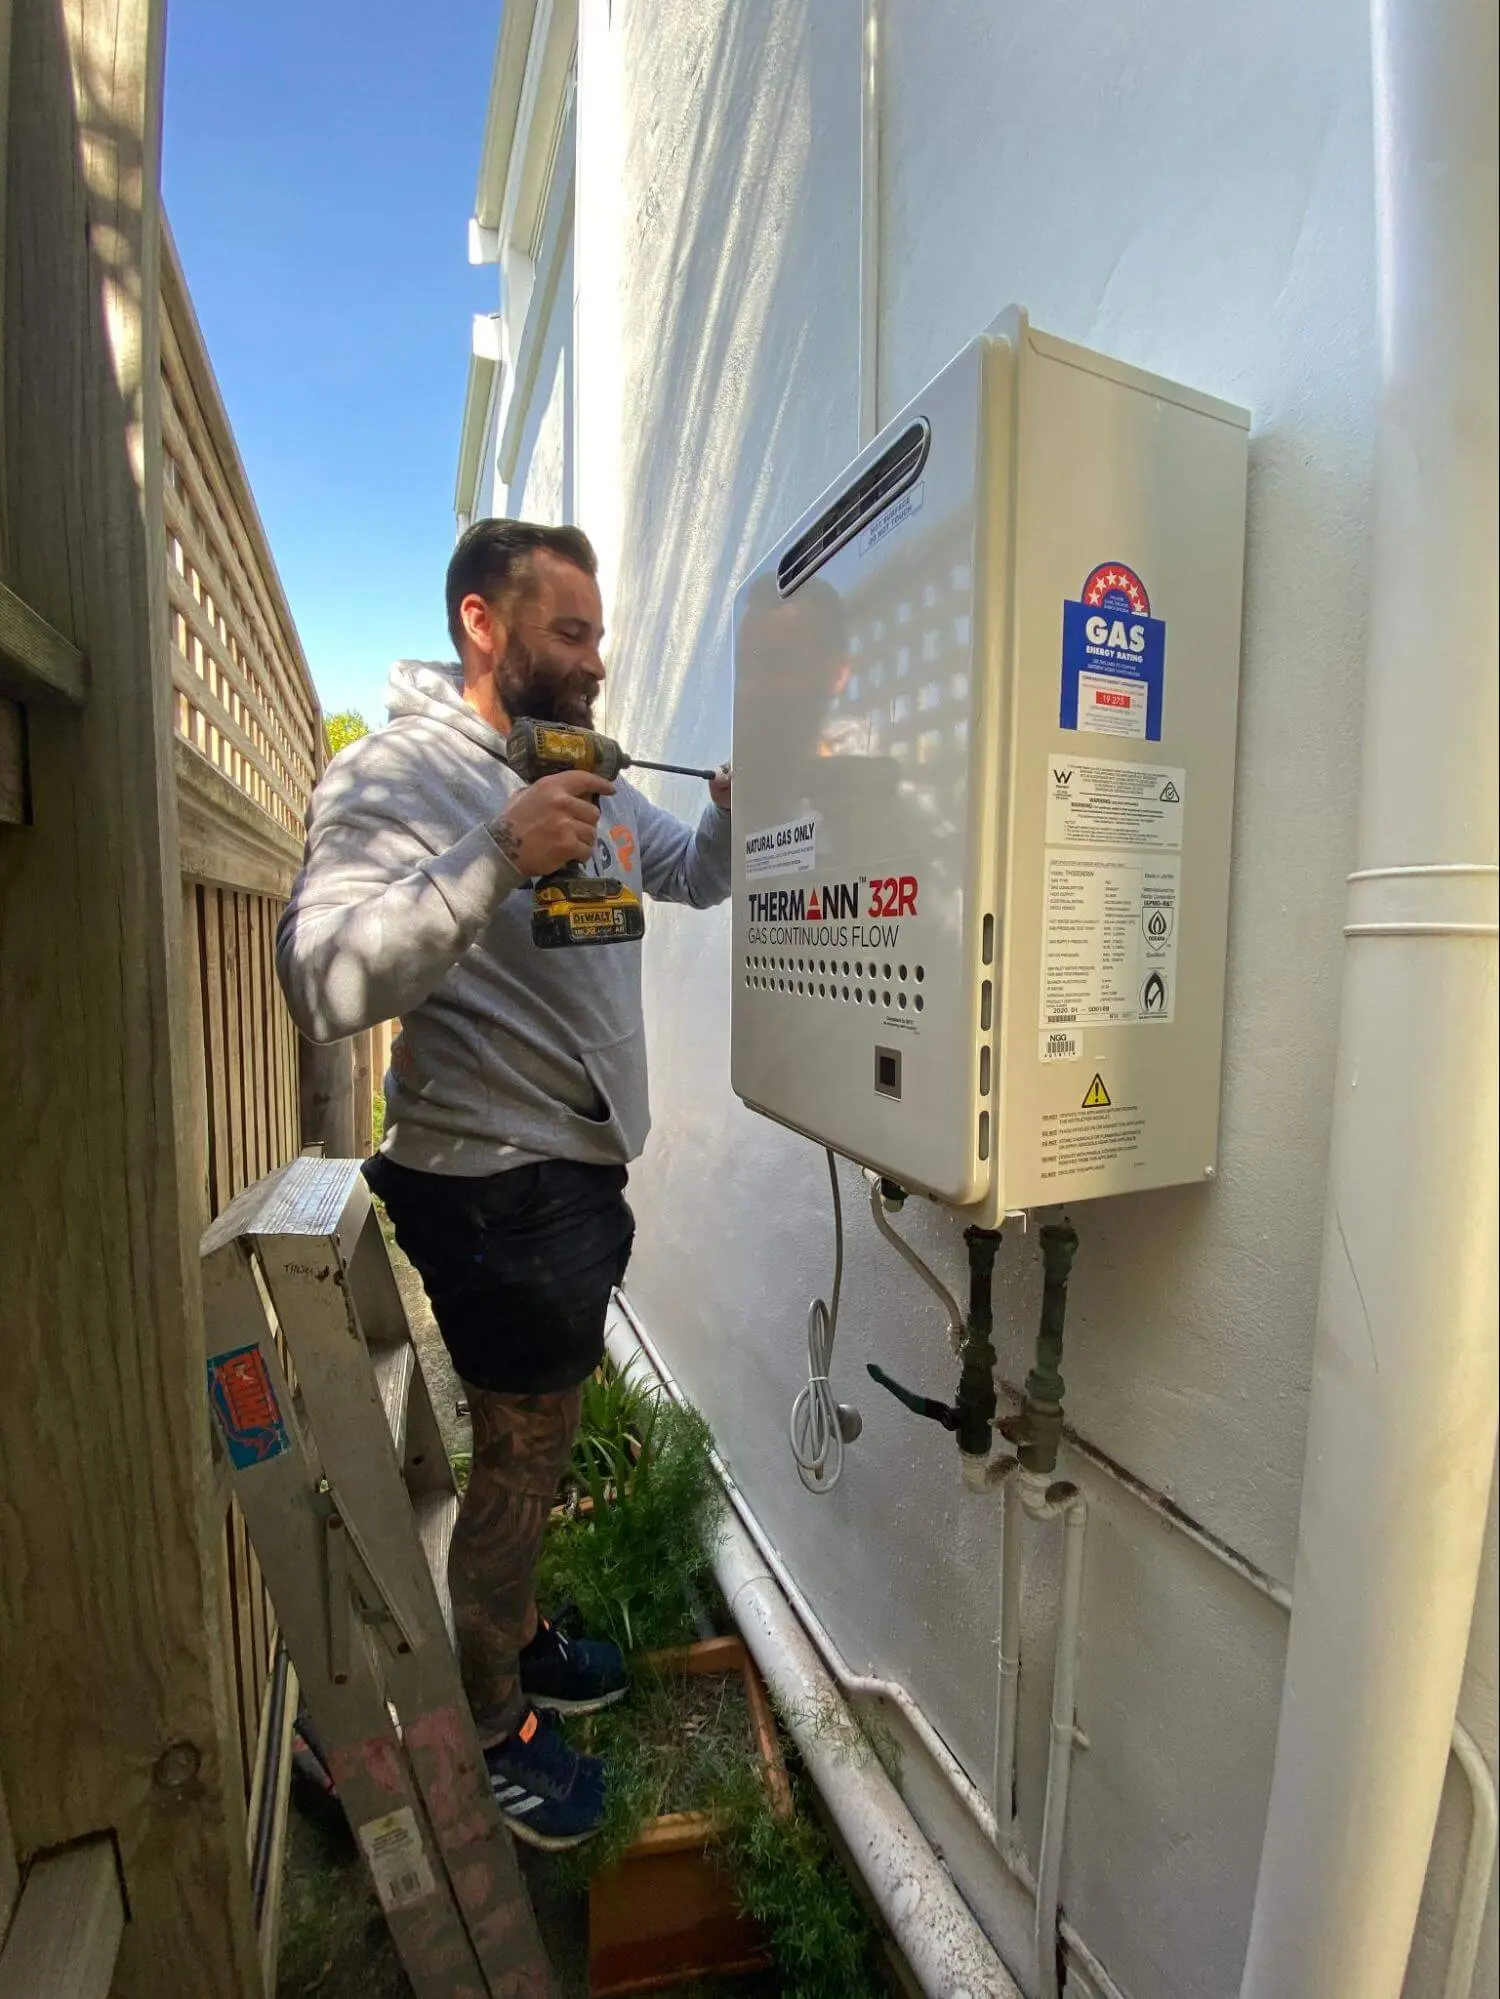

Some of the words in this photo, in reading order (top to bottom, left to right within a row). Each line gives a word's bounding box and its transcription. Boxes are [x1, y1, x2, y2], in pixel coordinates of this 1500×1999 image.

[1085, 615, 1145, 653] GAS
[1086, 645, 1116, 658] ENERGY
[1117, 651, 1144, 664] RATING
[746, 834, 775, 855] NATURAL
[776, 829, 792, 847] GAS
[794, 822, 815, 844] ONLY
[868, 875, 918, 918] 32R
[613, 909, 625, 926] 5
[748, 927, 767, 945] GAS
[769, 926, 848, 947] CONTINUOUS
[852, 925, 900, 948] FLOW
[1049, 1033, 1067, 1042] NGG
